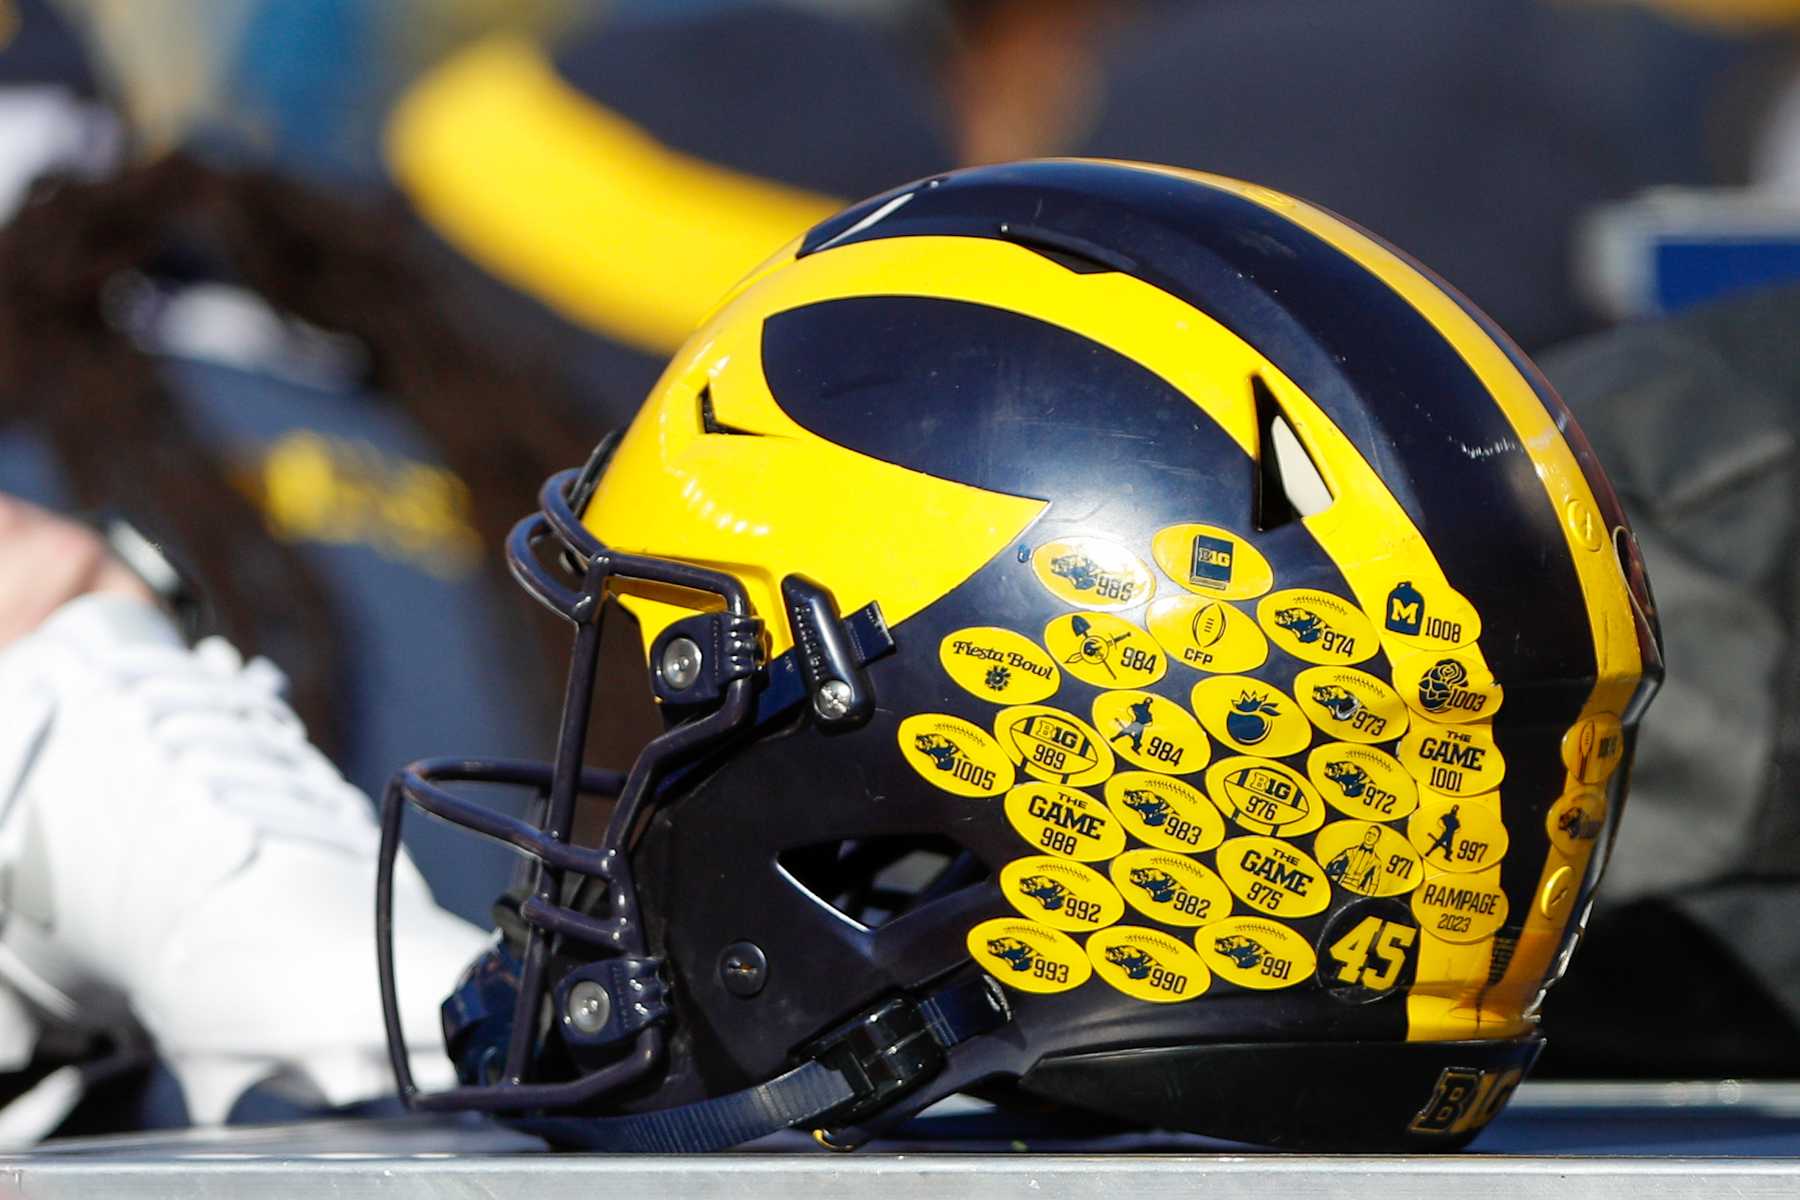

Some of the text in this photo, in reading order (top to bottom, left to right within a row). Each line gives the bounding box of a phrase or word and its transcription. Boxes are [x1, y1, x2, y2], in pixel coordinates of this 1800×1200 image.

[1391, 598, 1420, 624] M
[1425, 616, 1462, 643] 1008
[1183, 647, 1213, 666] CFP
[1322, 631, 1356, 657] 974
[952, 641, 1053, 680] Fiesta Bowl
[1120, 647, 1158, 675] 984
[1448, 689, 1487, 712] 1003
[1352, 713, 1388, 737] 973
[1446, 730, 1473, 742] THE
[1033, 743, 1066, 770] 989
[1146, 736, 1184, 767] 984
[1418, 738, 1487, 772] GAME
[952, 758, 996, 791] 1005
[1429, 767, 1463, 792] 1001
[1058, 792, 1088, 810] THE
[1245, 795, 1278, 821] 976
[1363, 785, 1397, 814] 972
[1028, 795, 1105, 840] GAME
[1164, 815, 1202, 846] 983
[1040, 827, 1077, 856] 988
[1457, 840, 1488, 863] 997
[1272, 848, 1300, 866] THE
[1386, 854, 1414, 880] 971
[1240, 849, 1314, 898] GAME
[1173, 891, 1211, 919] 982
[1247, 881, 1284, 910] 975
[1423, 884, 1500, 916] RAMPAGE
[1065, 898, 1101, 923] 992
[1437, 913, 1472, 933] 2023
[1329, 915, 1417, 991] 45
[1033, 959, 1069, 984] 993
[1150, 967, 1187, 995] 990
[1261, 956, 1292, 981] 991
